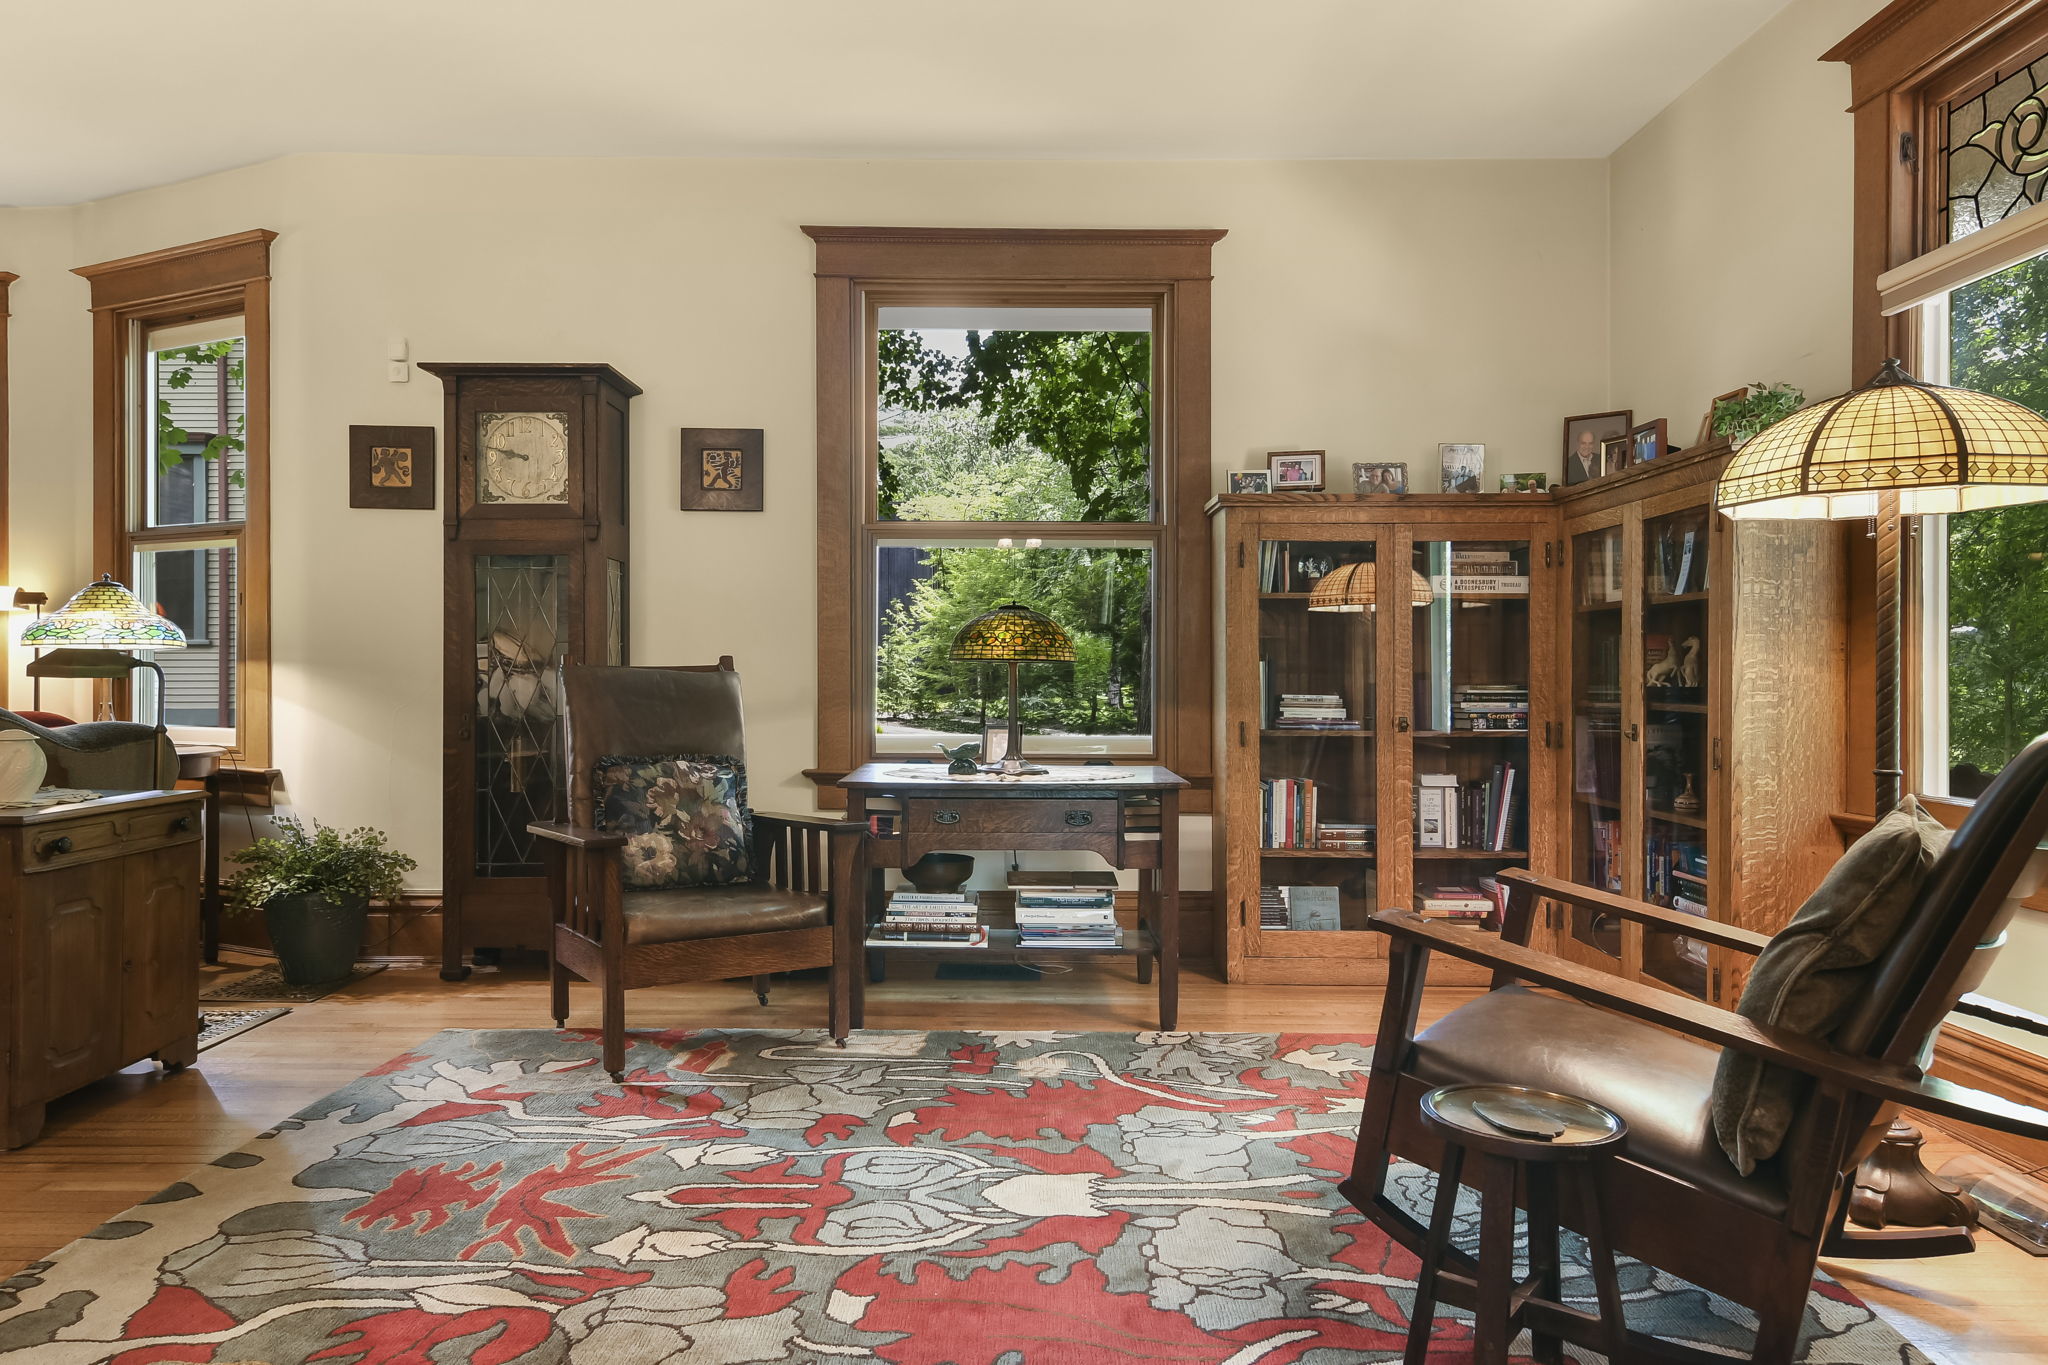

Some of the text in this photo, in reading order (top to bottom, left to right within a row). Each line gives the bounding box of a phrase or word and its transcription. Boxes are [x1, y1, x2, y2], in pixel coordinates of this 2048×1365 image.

[506, 421, 515, 437] 11
[519, 417, 532, 434] 12
[540, 421, 545, 437] 1
[492, 433, 506, 449] 10
[550, 433, 559, 448] 2
[487, 450, 498, 467] 9
[554, 448, 566, 465] 3
[506, 478, 516, 496] 7
[521, 480, 531, 498] 6
